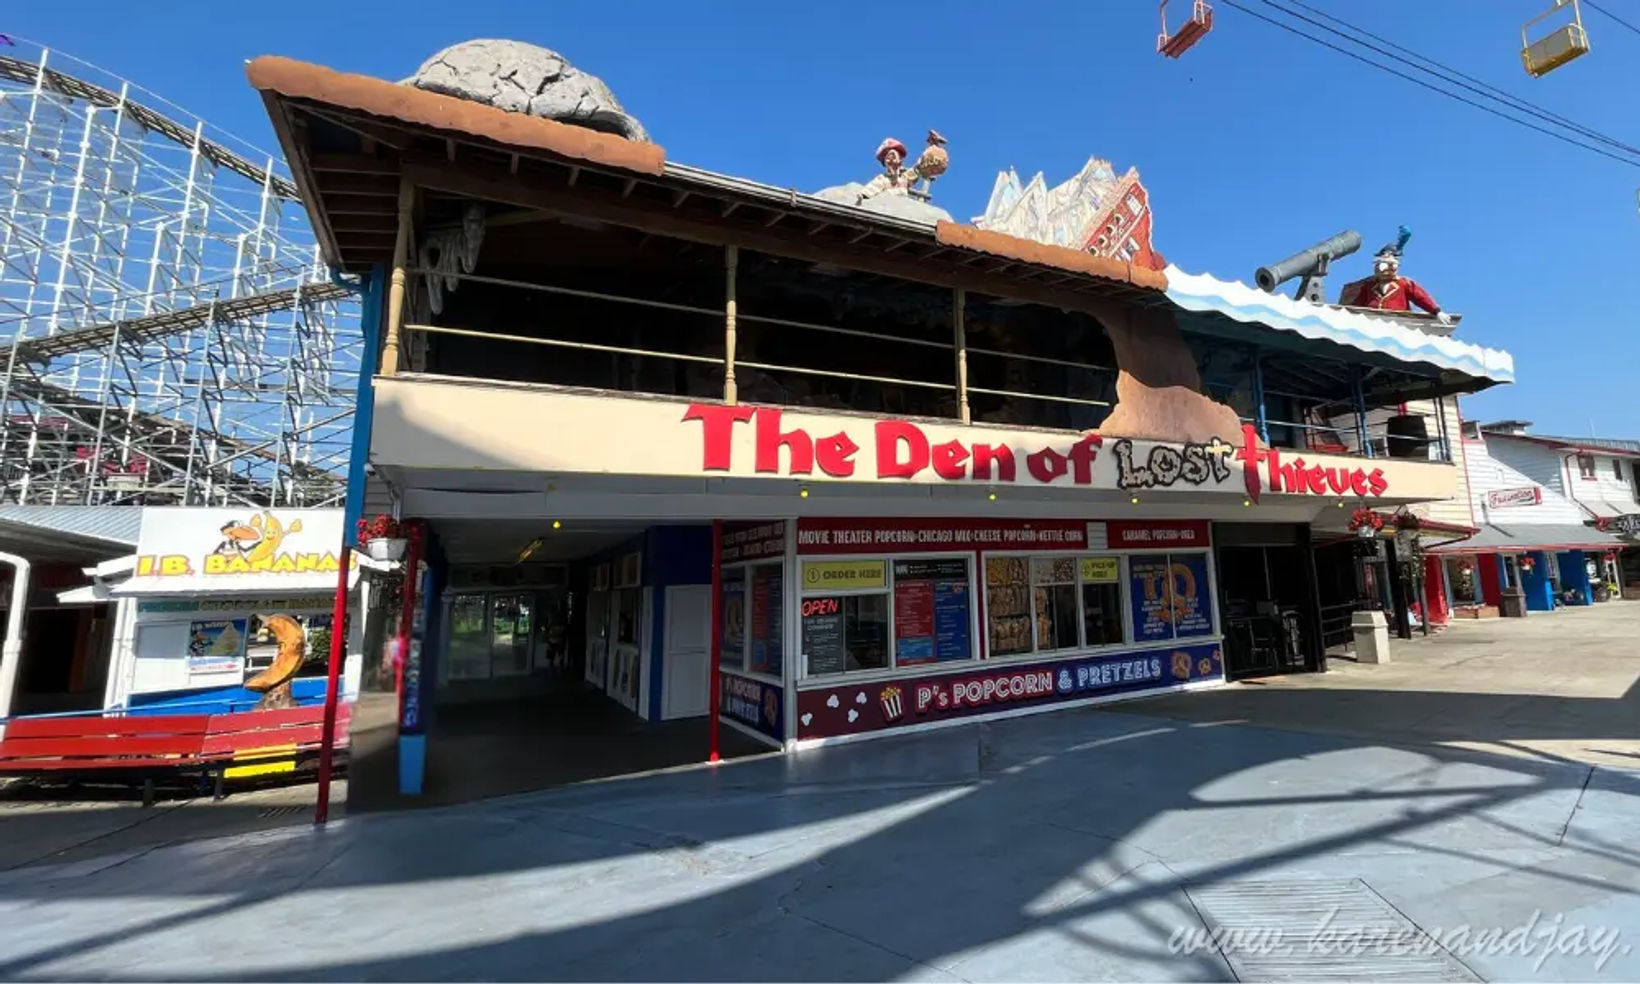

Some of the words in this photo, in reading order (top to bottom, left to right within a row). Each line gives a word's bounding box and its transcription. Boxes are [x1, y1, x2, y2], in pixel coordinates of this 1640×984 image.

[681, 402, 860, 477] The
[875, 420, 1016, 482] Den
[1027, 434, 1103, 484] of
[798, 529, 830, 545] MOVIE
[833, 529, 872, 545] THEATER
[801, 599, 839, 618] OPEN
[917, 687, 949, 709] P's
[953, 672, 1053, 705] POPCORN
[1057, 669, 1073, 690] &
[1077, 658, 1161, 687] PRETZELS
